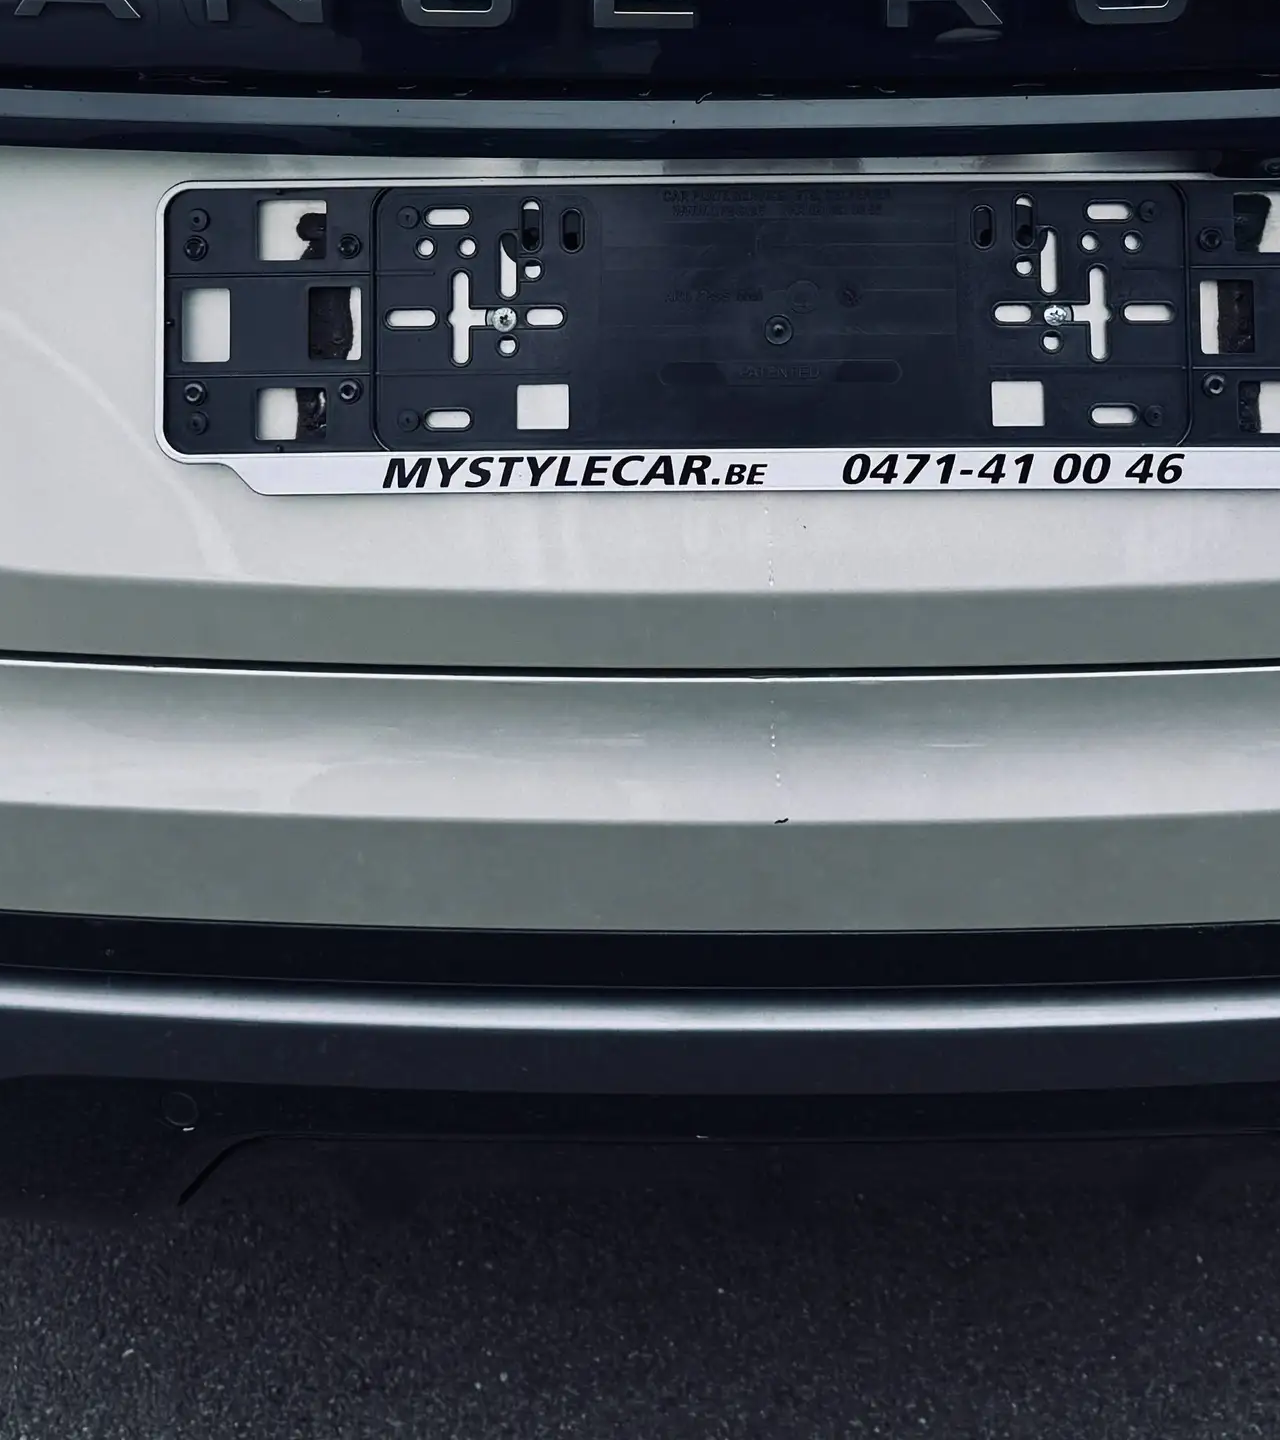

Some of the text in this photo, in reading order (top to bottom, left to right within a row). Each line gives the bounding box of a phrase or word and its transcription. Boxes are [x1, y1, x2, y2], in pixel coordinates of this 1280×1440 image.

[382, 453, 1184, 488] MYSTYLECAR.BE 0471-41 00 46
